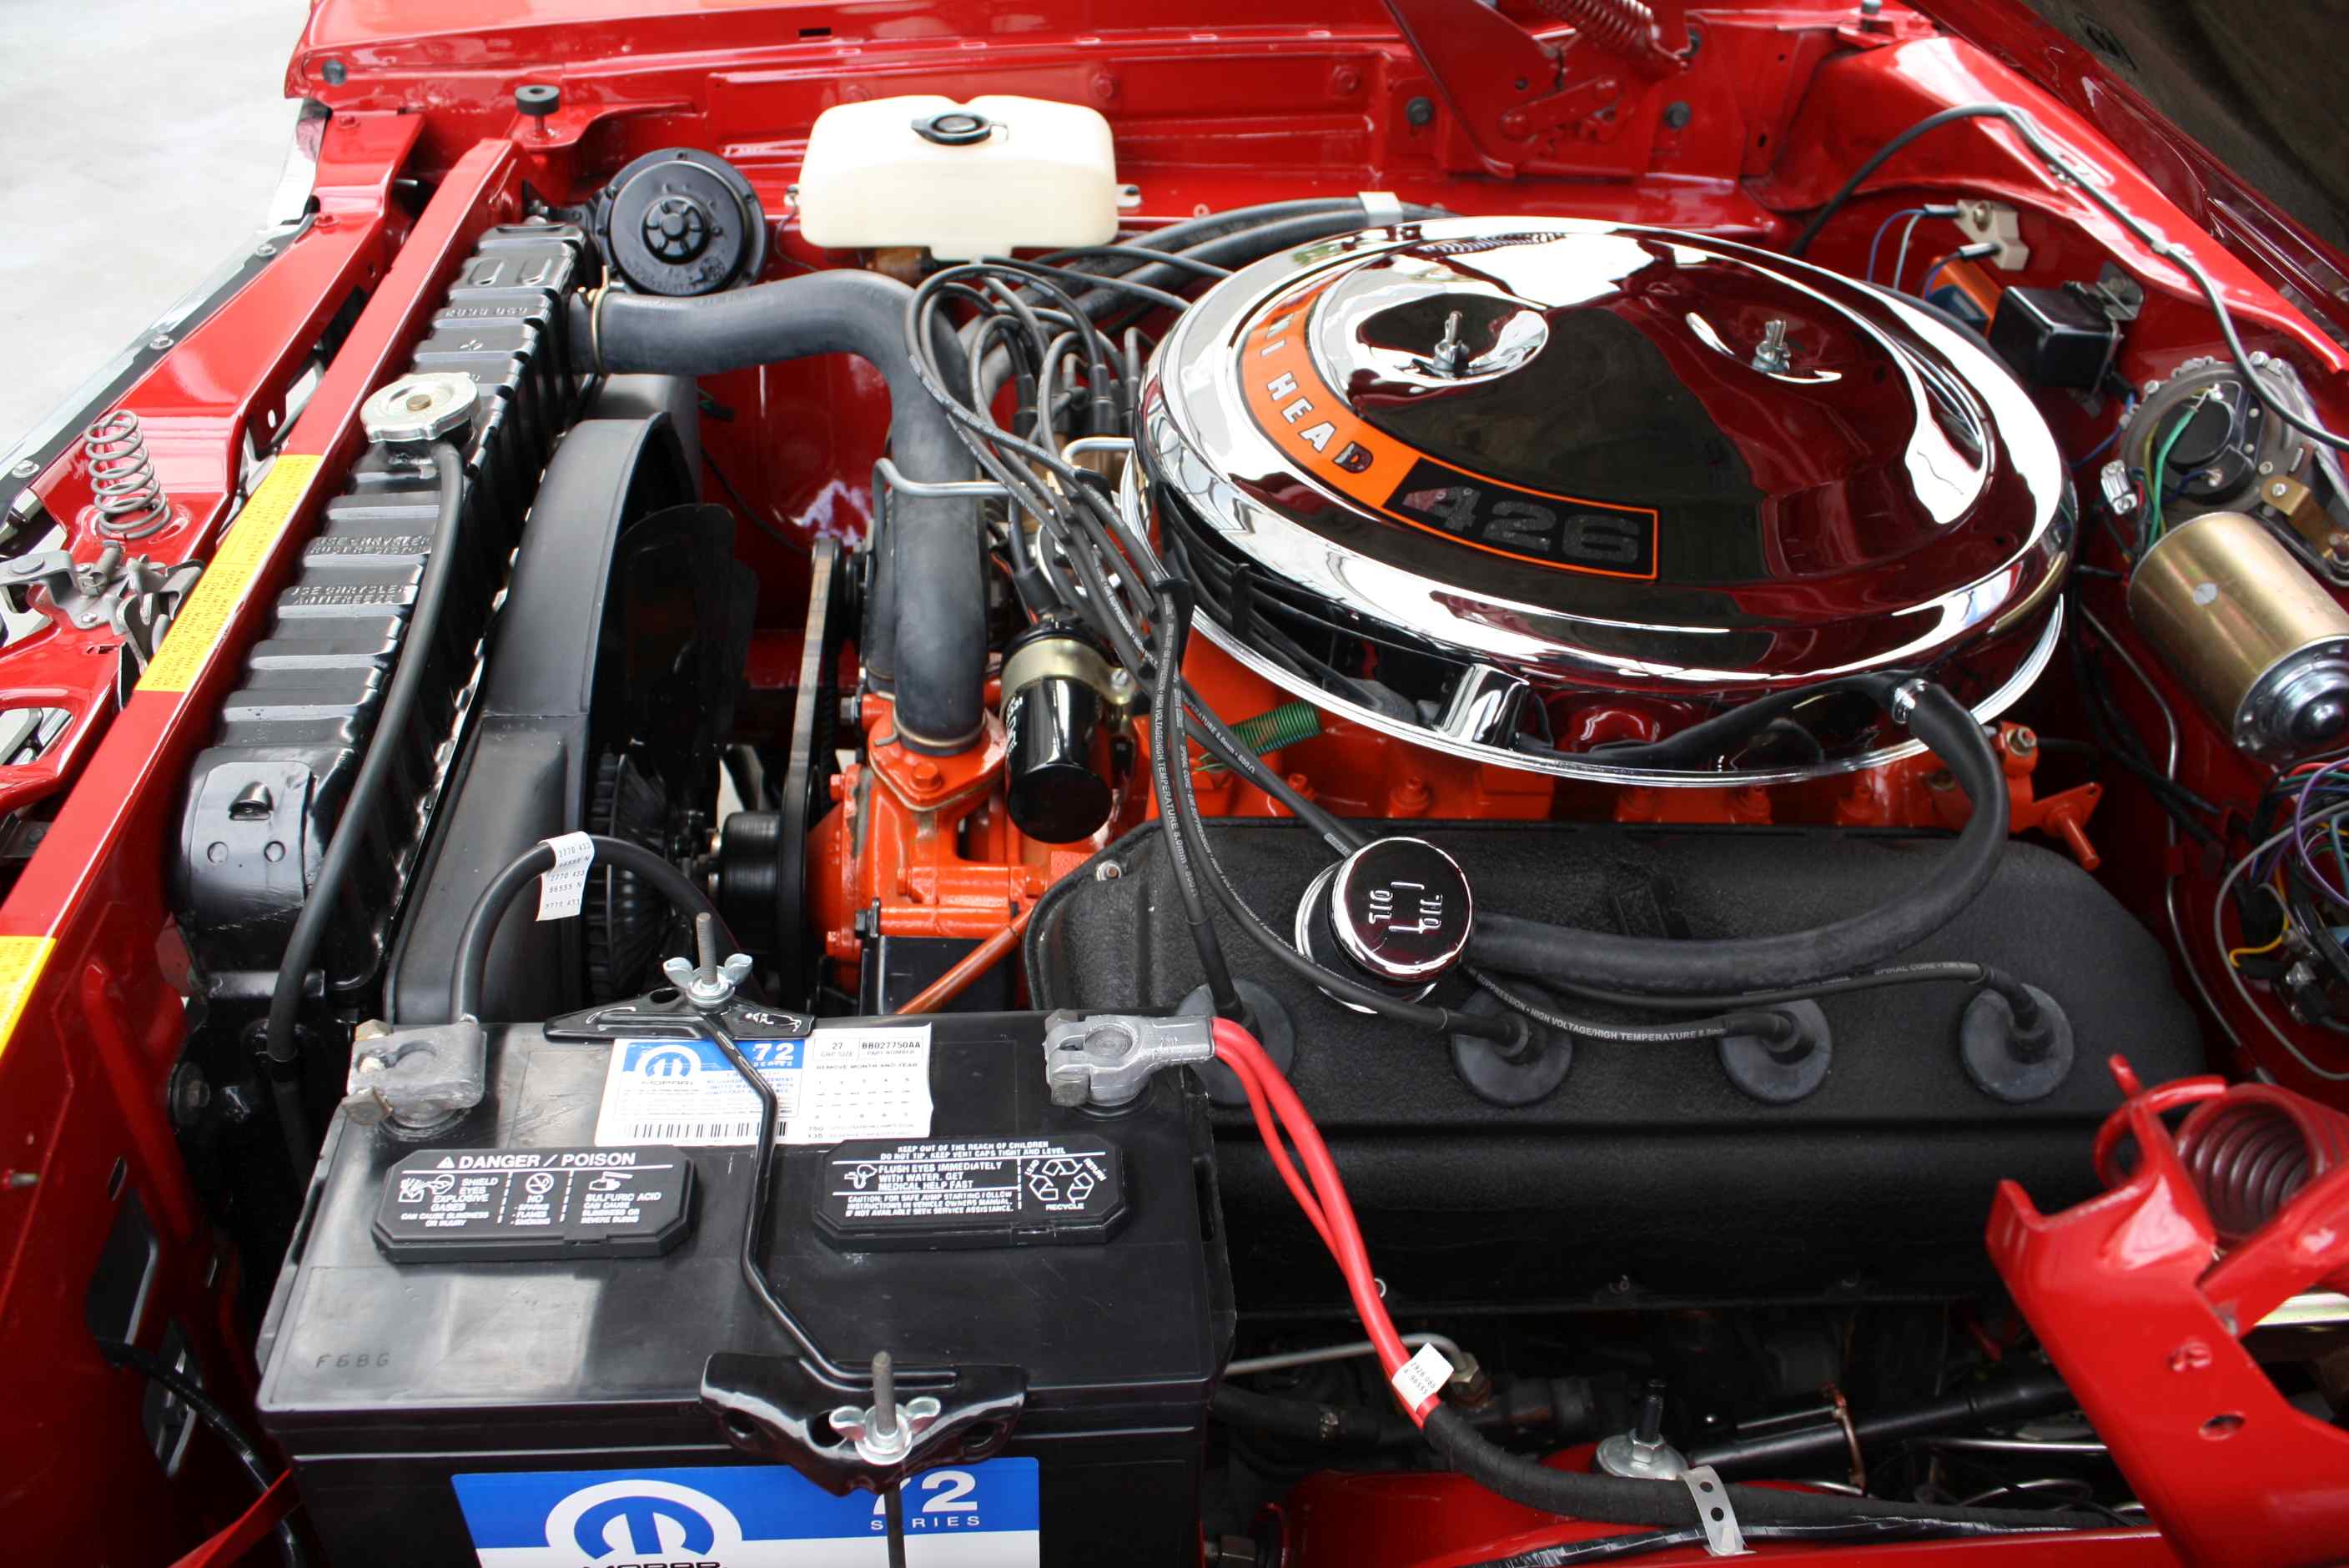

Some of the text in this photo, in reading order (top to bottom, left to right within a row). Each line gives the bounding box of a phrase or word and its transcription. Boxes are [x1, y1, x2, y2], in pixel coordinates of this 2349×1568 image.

[1266, 372, 1374, 474] HEAD
[1402, 486, 1640, 564] 426
[1157, 761, 1180, 830] TEMPERATURE
[1420, 894, 1443, 930] OIL
[1476, 973, 1527, 1012] SUPPRESSION
[1530, 1008, 1550, 1023] HIGH
[1552, 1016, 1617, 1040] VOLTAGE/HIGH
[1620, 1029, 1696, 1042] TEMPERATURE
[753, 1043, 795, 1061] 72
[898, 1141, 1049, 1153] KEEP OUT OF THE REACH OF CHILDREN
[974, 1149, 995, 1158] CAPS
[1024, 1148, 1041, 1156] AND
[1043, 1147, 1066, 1155] LEVEL
[459, 1155, 541, 1168] DANGER
[561, 1153, 636, 1166] POISON
[878, 1161, 1003, 1173] FLUSH EYES IMMEDIATELY
[461, 1178, 499, 1187] SHIELD
[878, 1173, 903, 1183] WITH
[945, 1172, 964, 1180] GET
[459, 1186, 486, 1195] EYES
[878, 1180, 973, 1191] MEDICAL HELP FAST
[432, 1194, 490, 1204] EXPLOSIVE
[526, 1194, 544, 1204] NO
[585, 1192, 661, 1203] SULFURIC ACID
[883, 1194, 897, 1203] FOR
[430, 1203, 466, 1212] GASES
[1045, 1203, 1085, 1211] RECYCLE
[870, 1515, 981, 1531] SRIES
